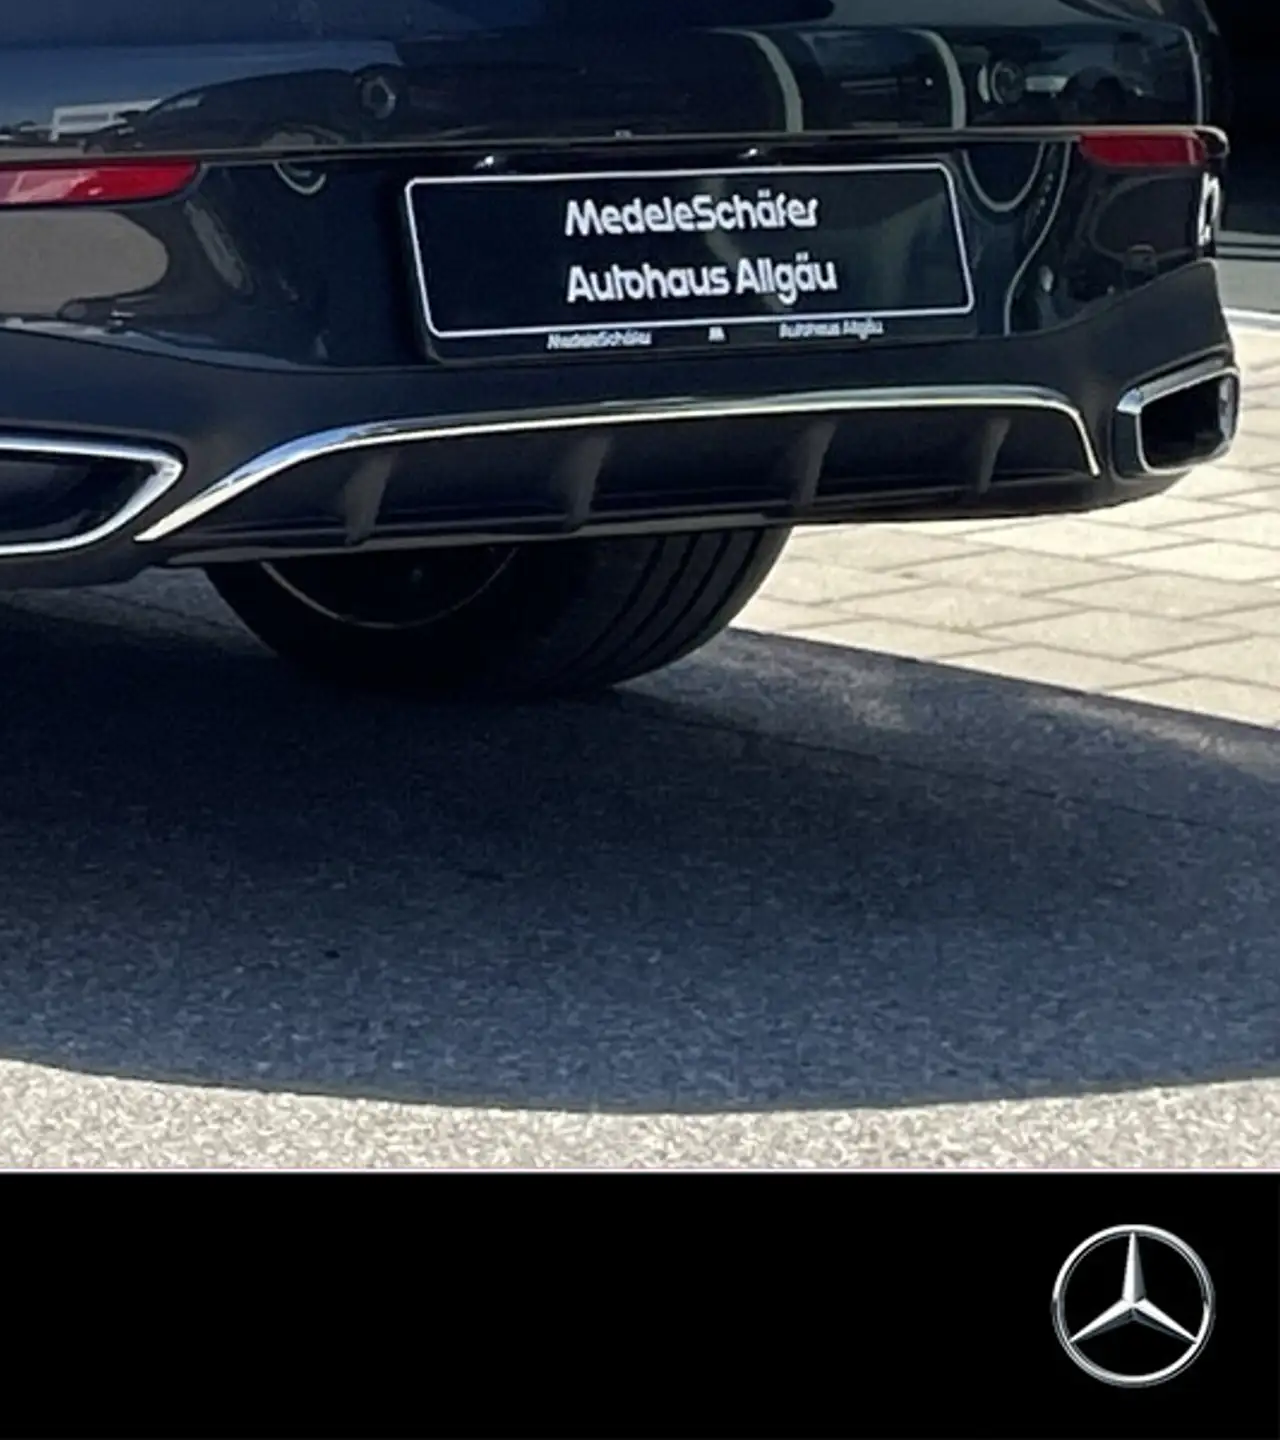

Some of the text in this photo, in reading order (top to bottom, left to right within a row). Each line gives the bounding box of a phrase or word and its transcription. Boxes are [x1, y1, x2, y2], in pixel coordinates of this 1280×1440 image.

[565, 189, 818, 236] MedeleSchäfer
[566, 251, 838, 304] Autohaus Allgäu
